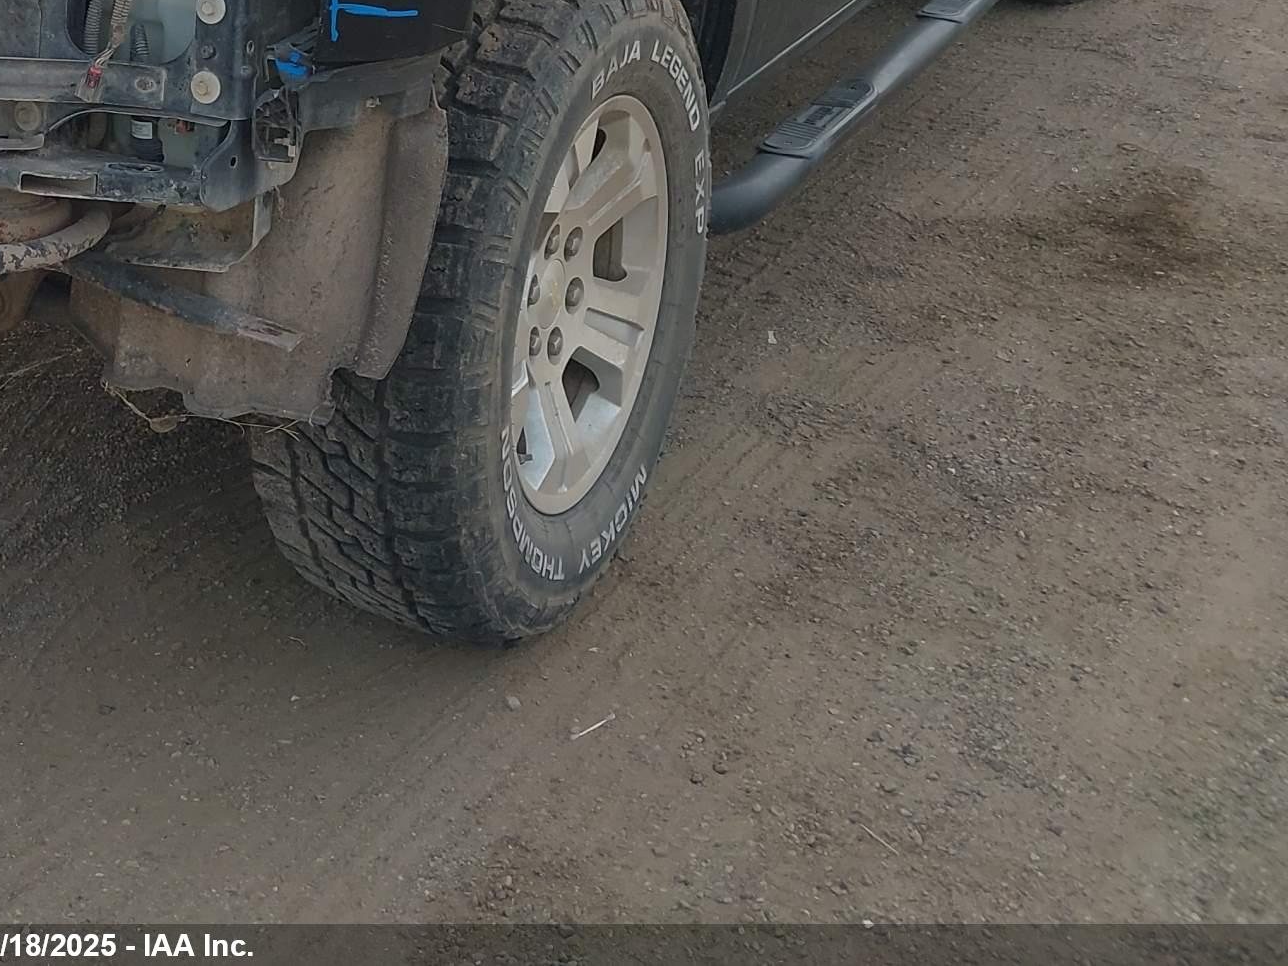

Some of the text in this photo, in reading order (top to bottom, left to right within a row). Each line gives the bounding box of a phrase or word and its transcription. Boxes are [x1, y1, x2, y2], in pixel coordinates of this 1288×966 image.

[591, 39, 706, 235] BAJA LEGEND EXP
[500, 425, 648, 581] MICKEY THOMPSON
